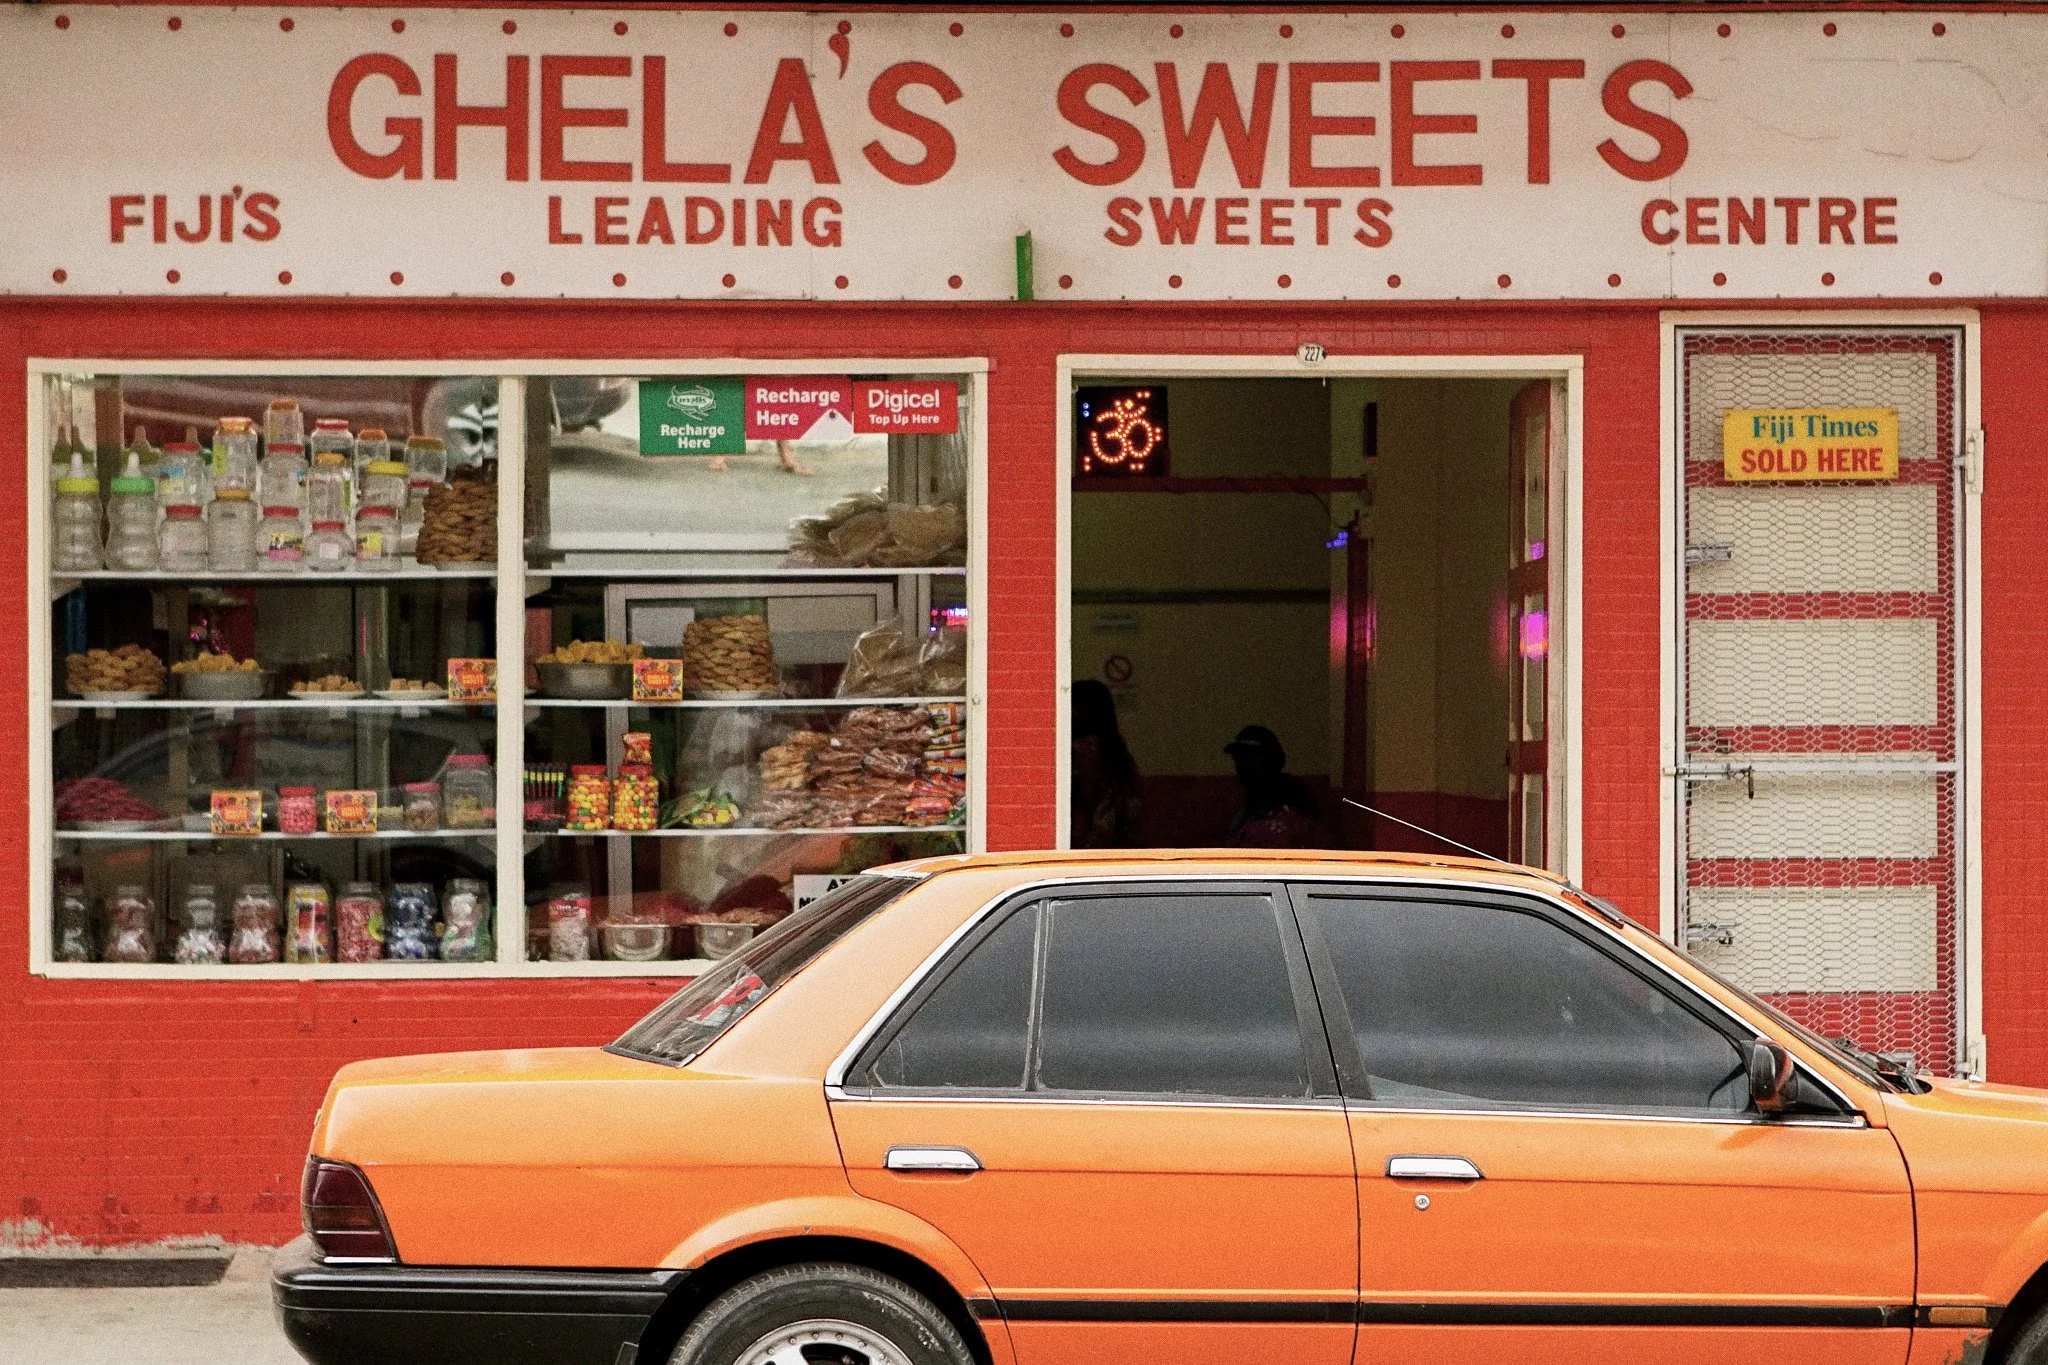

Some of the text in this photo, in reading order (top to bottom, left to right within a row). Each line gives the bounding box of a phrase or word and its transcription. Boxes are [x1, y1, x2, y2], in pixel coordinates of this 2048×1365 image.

[327, 34, 1693, 189] GHELA'S SWEETS
[110, 186, 1897, 248] FIJI'S LEADING SWEETS CENTRE
[1305, 346, 1321, 361] 227
[756, 388, 841, 405] Recharge
[868, 389, 940, 412] Digicel
[756, 410, 800, 425] Here
[869, 413, 940, 427] Top Up Here
[660, 424, 725, 438] Recharge
[1753, 415, 1878, 444] Fiji Times
[678, 437, 711, 449] Here
[1741, 448, 1884, 473] SOLD HERE
